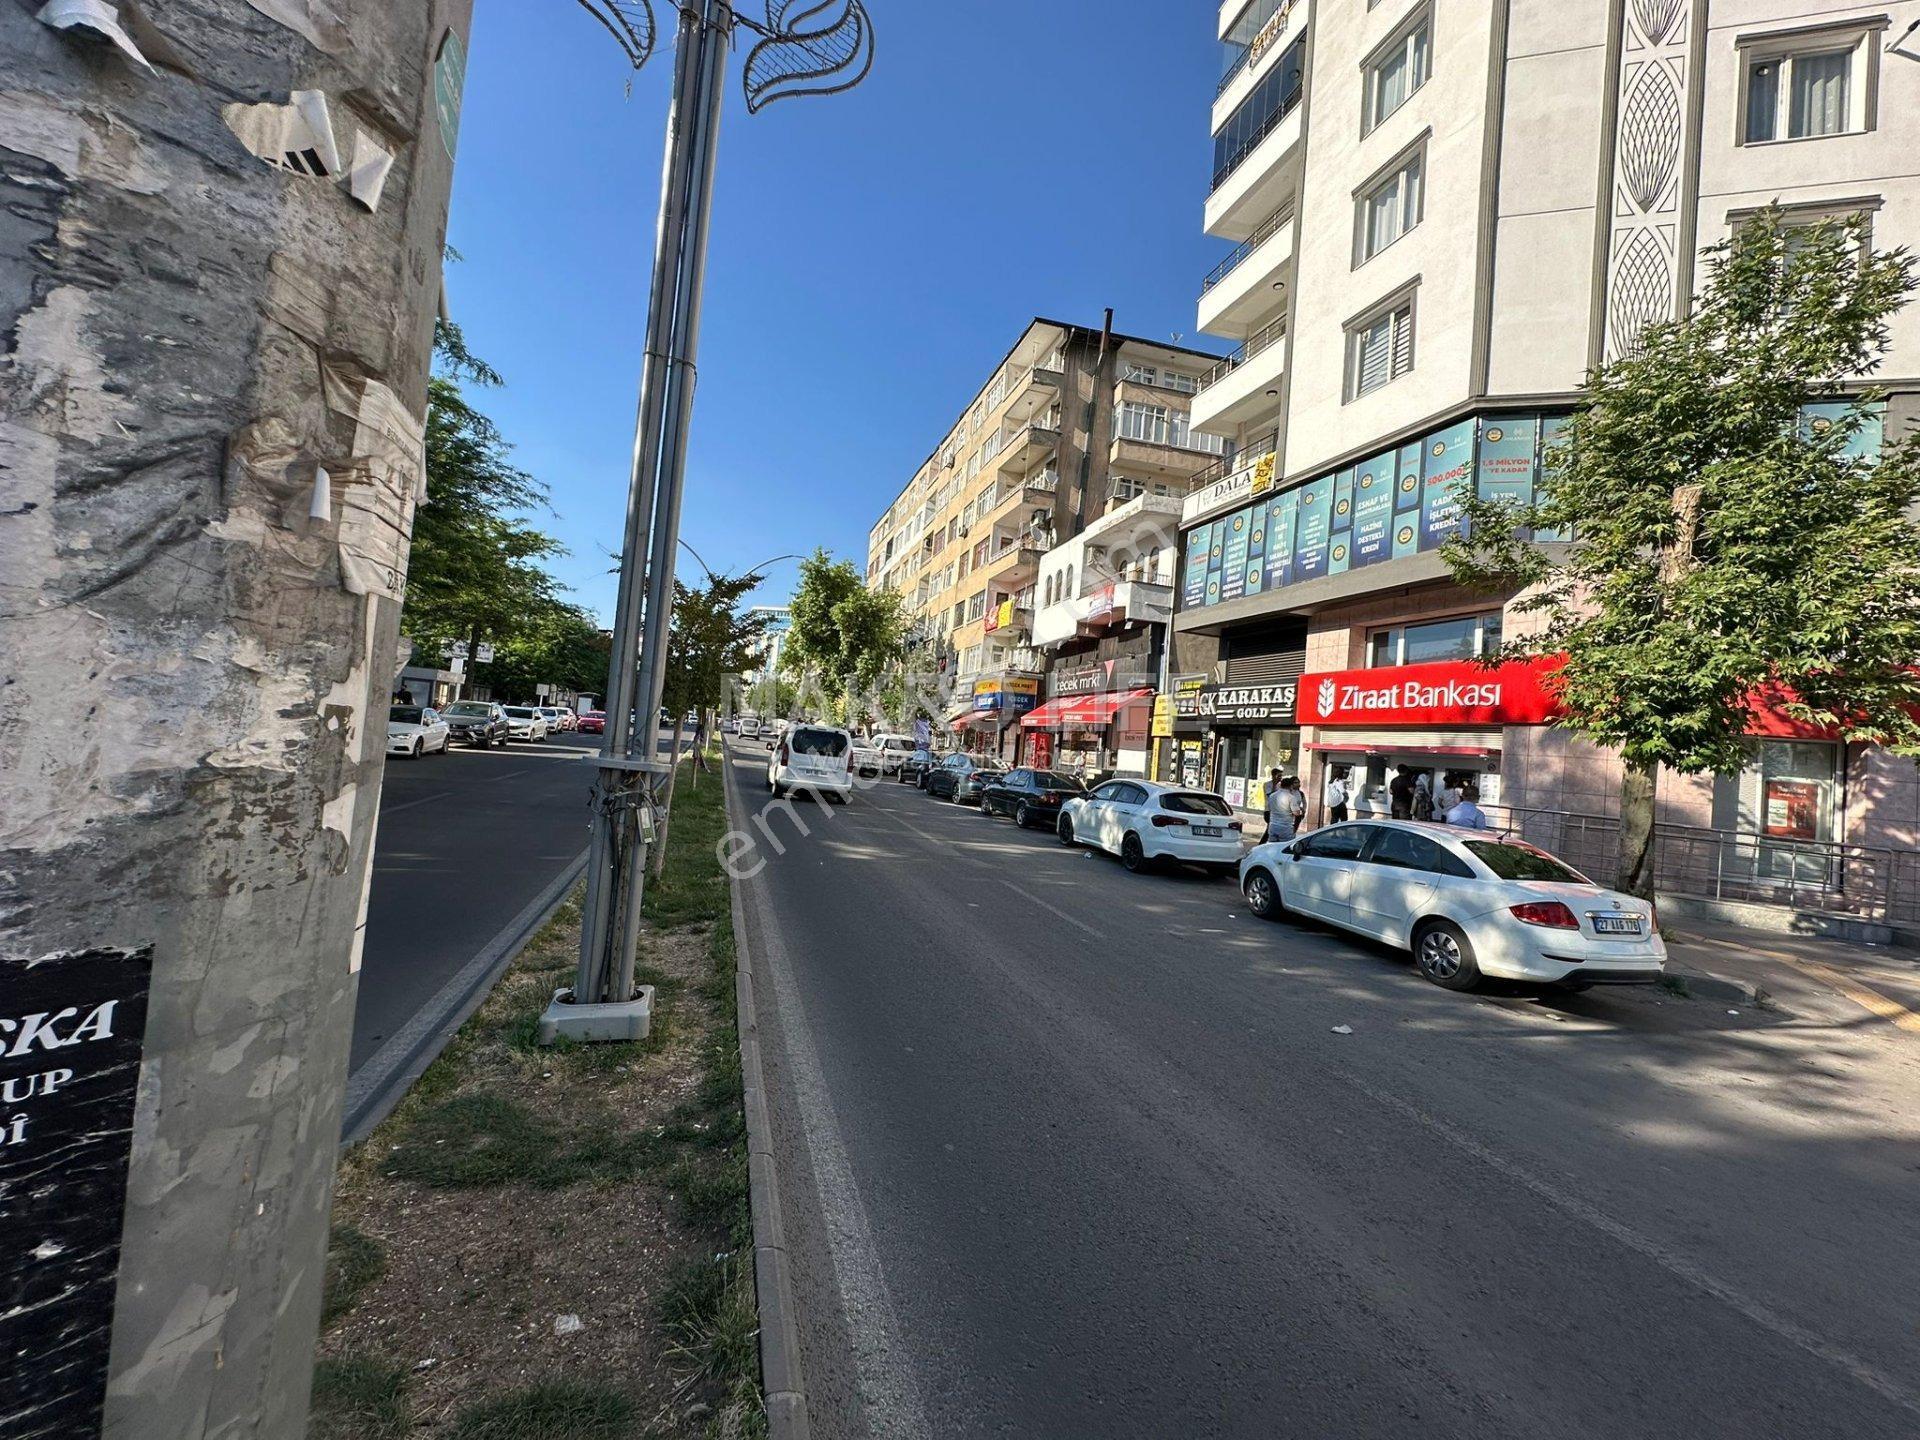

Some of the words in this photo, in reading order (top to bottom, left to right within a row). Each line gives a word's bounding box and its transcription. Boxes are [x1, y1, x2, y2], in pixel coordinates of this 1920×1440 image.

[1496, 456, 1530, 466] MİLYON
[1217, 686, 1296, 708] KARAKAŞ
[1340, 684, 1401, 710] Ziraat
[1404, 679, 1501, 708] Bankası
[1231, 707, 1269, 719] GOLD
[0, 1112, 30, 1146] Î
